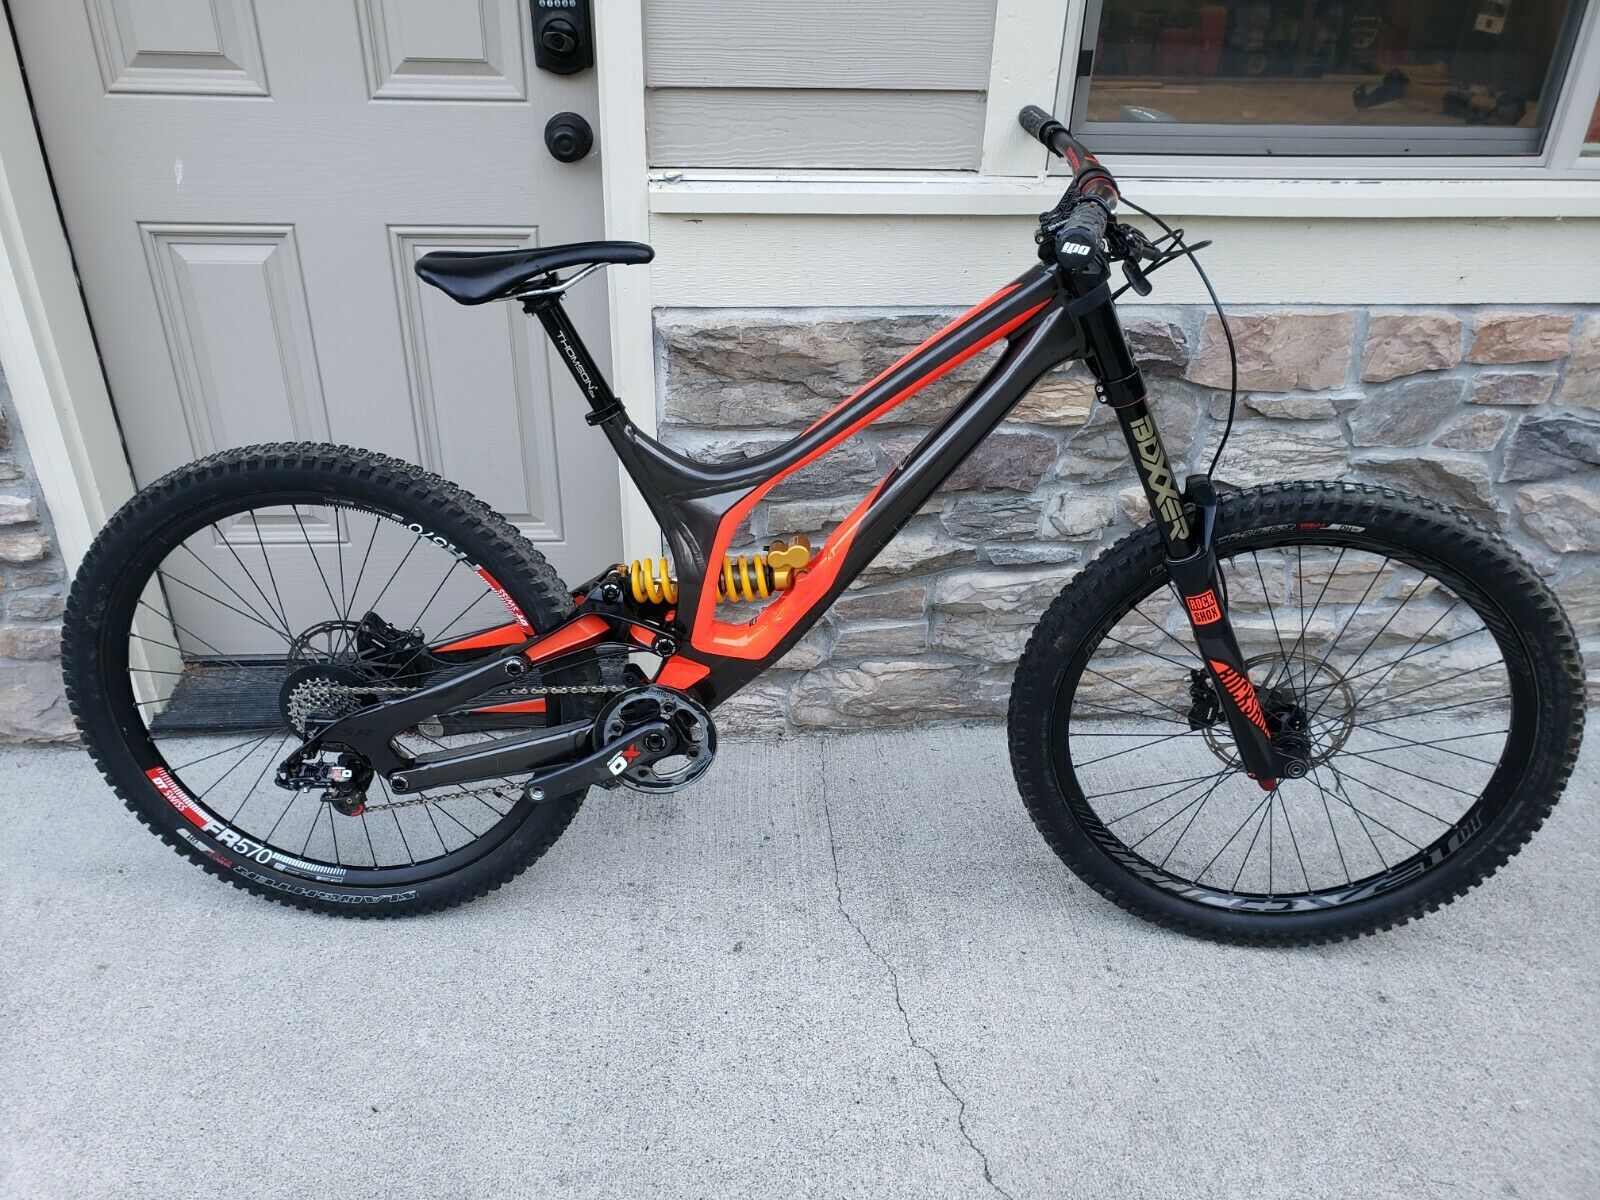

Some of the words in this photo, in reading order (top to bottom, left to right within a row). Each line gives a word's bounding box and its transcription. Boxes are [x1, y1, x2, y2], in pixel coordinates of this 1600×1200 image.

[558, 330, 595, 390] THOMSON
[1129, 414, 1190, 541] BOXXER
[1188, 592, 1216, 612] ROCK
[1193, 608, 1219, 623] SHOX
[152, 777, 168, 789] DT
[163, 789, 187, 812] SWISS
[200, 818, 273, 864] FR570
[233, 865, 416, 904] SLAUGHTER
